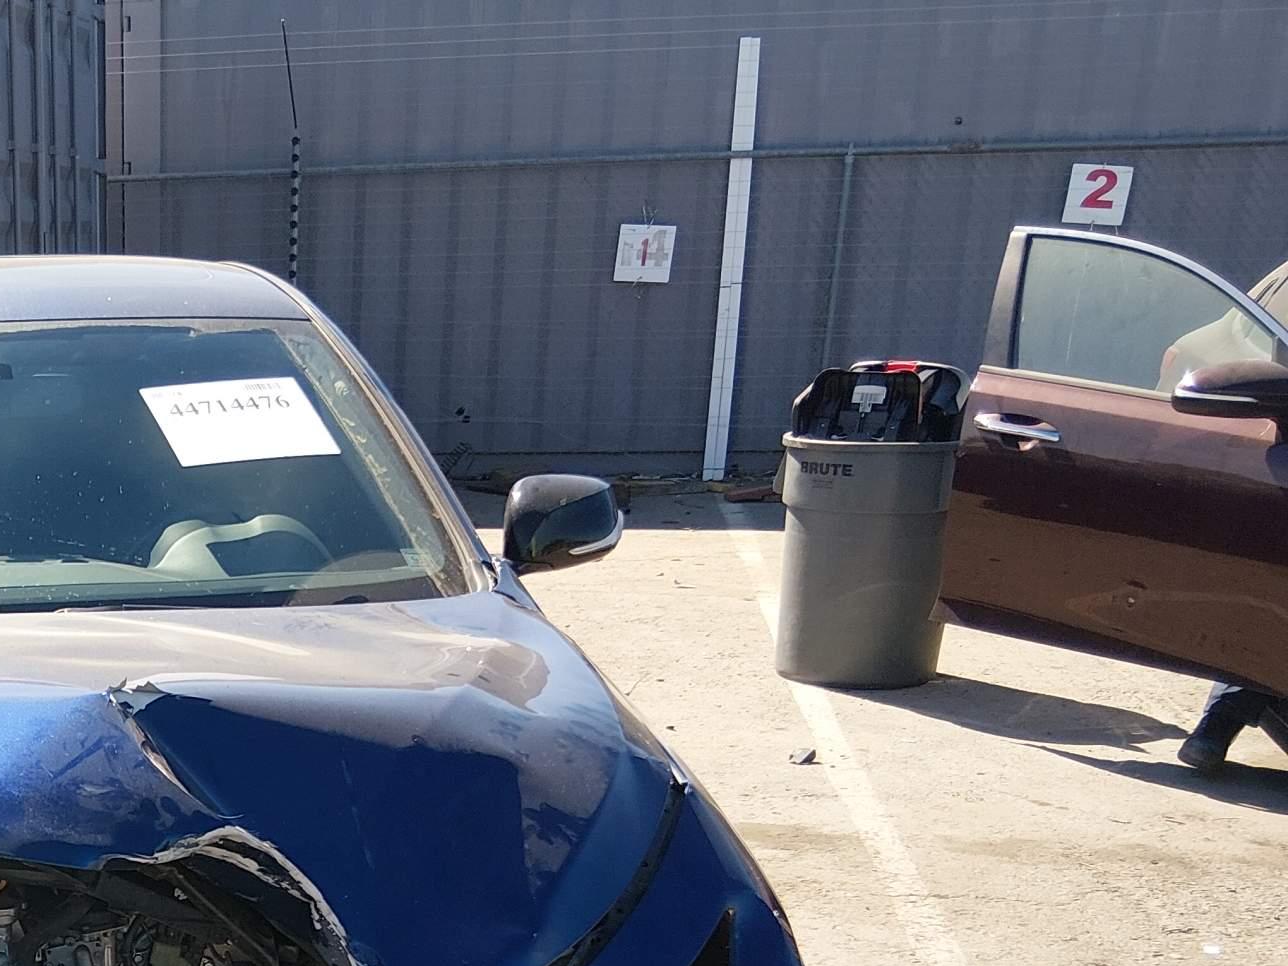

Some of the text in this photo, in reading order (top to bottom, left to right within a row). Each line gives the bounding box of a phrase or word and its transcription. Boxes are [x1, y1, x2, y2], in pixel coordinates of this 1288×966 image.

[1079, 168, 1118, 209] 2
[169, 394, 291, 417] 44714476
[800, 461, 853, 477] BRUTE
